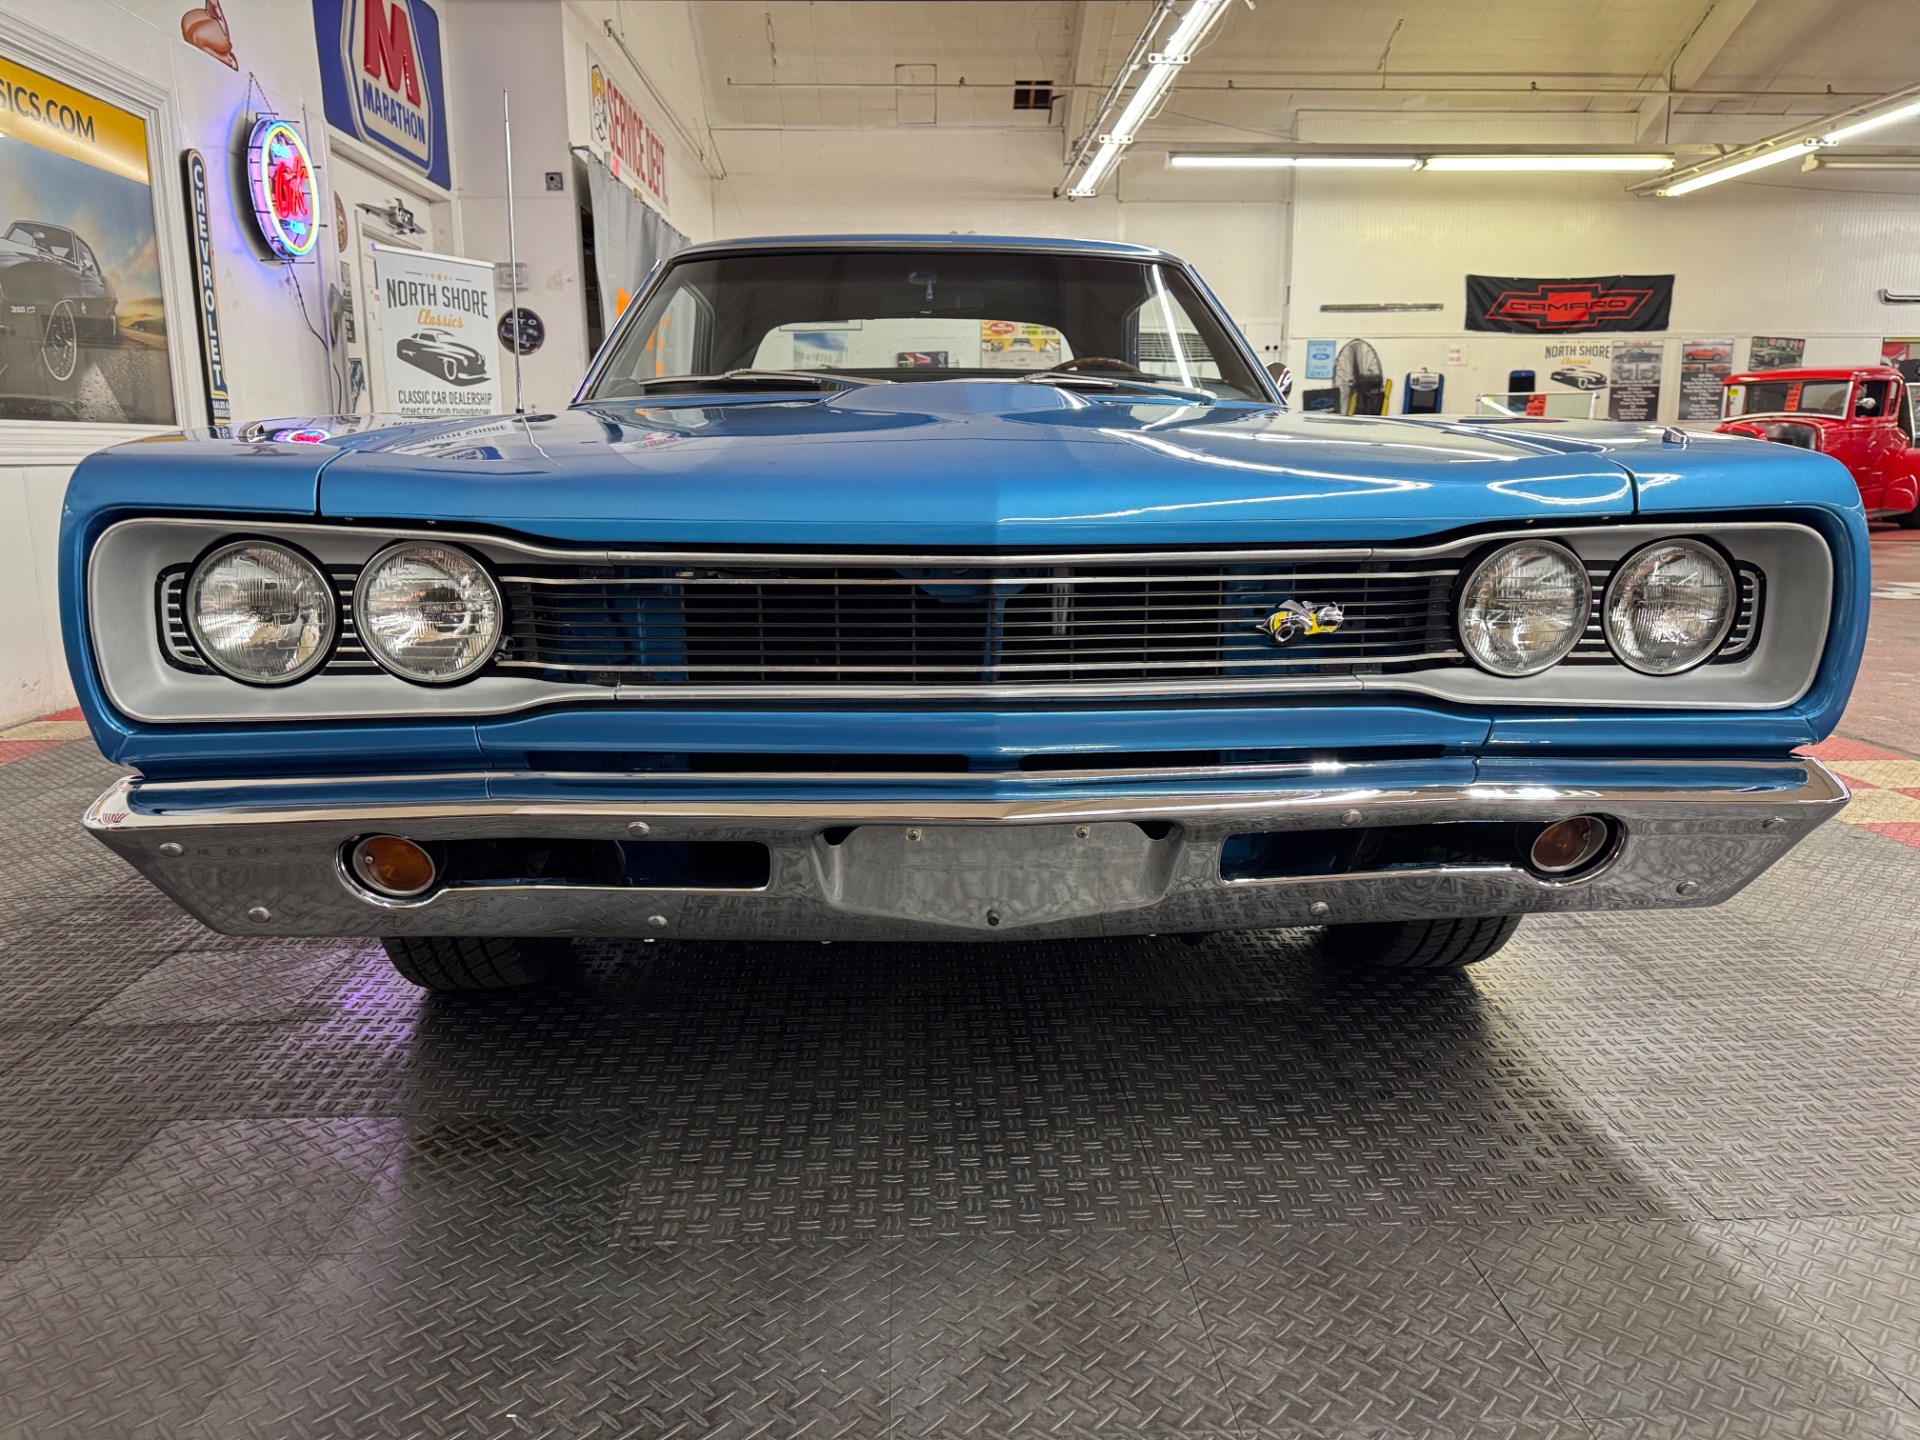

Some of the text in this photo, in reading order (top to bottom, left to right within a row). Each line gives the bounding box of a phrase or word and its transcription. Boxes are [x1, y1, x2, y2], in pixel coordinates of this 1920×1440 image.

[364, 0, 421, 109] M
[362, 78, 426, 145] MARATHON
[606, 78, 669, 206] SERVICE DEPT.
[193, 164, 223, 386] CHEVROLET
[386, 278, 489, 319] NORTH SHORE
[417, 308, 464, 329] Classics
[1510, 299, 1627, 311] CAMARO
[1545, 345, 1611, 359] NORTH SHORE
[398, 390, 492, 406] CLASSIC CAR DEALERSHIP
